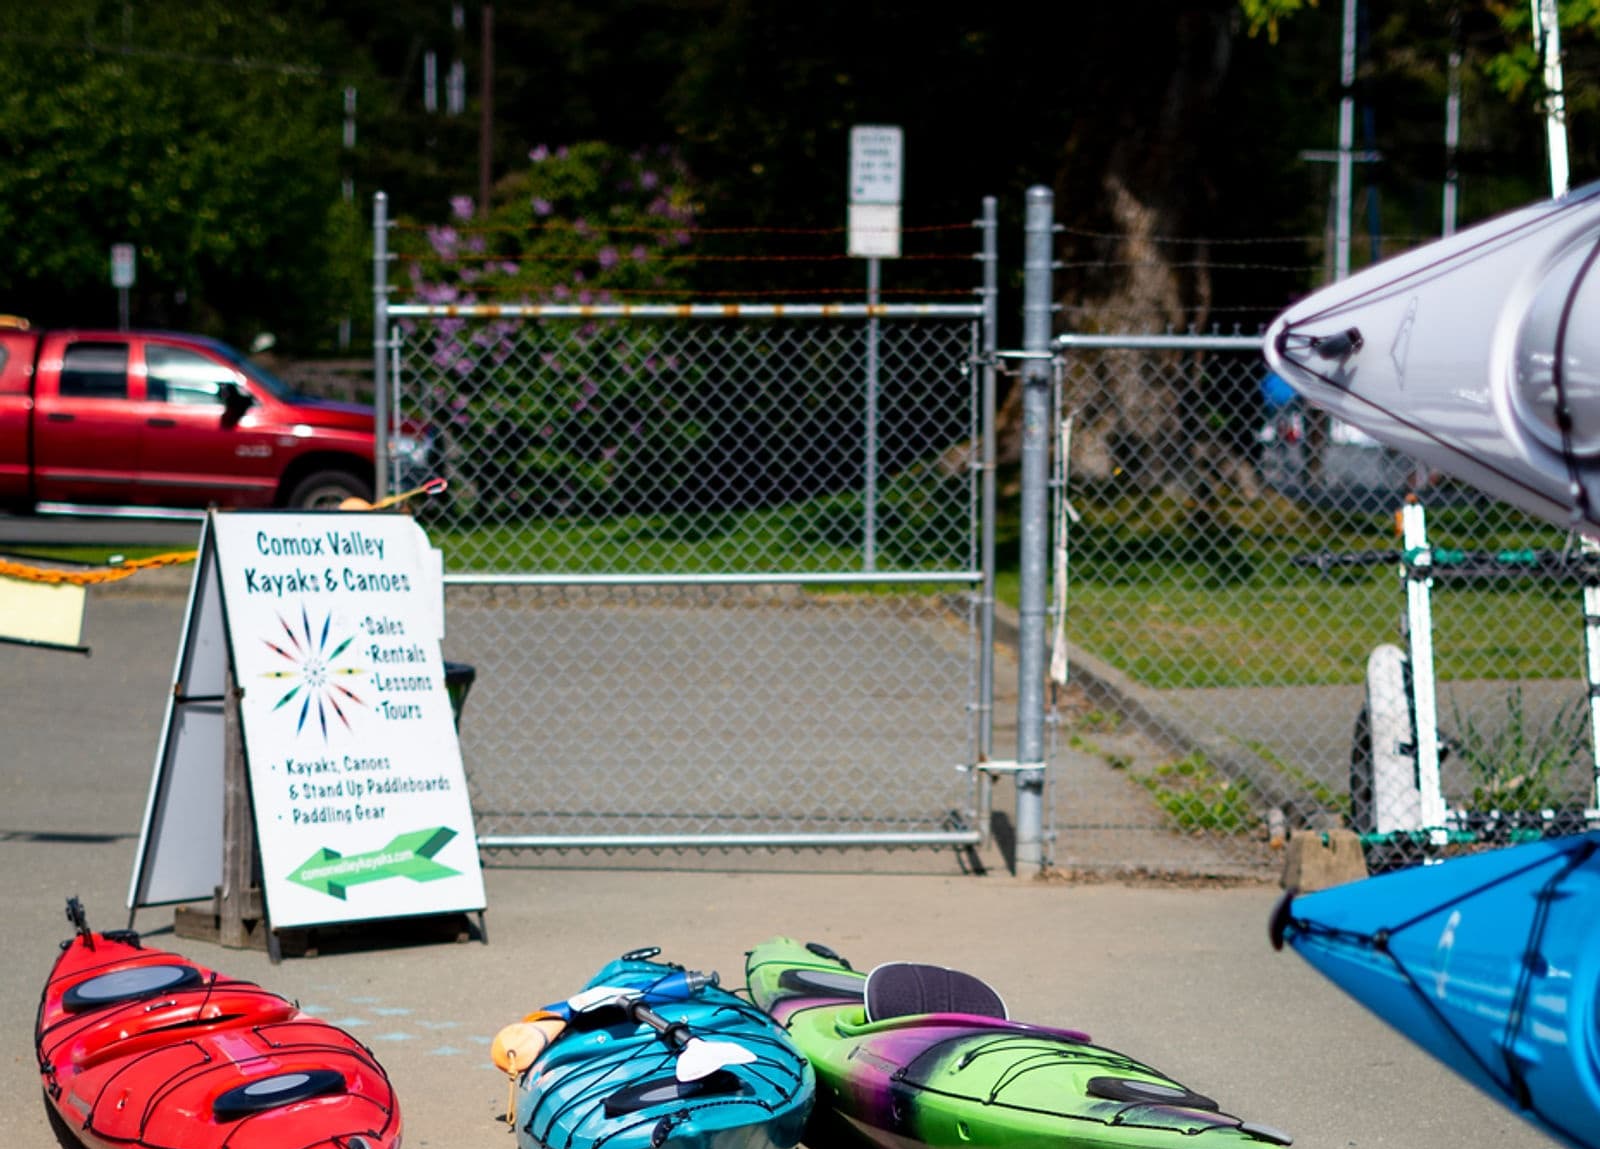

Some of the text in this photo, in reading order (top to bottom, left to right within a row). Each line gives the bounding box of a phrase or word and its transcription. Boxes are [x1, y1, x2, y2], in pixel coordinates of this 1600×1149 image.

[257, 531, 384, 560] Comox Valley
[245, 567, 411, 597] Kayaks & Canoes
[365, 616, 404, 635] Sales
[371, 643, 426, 664] Rentals
[375, 672, 433, 691] Lessons
[382, 700, 422, 720] Tours
[286, 756, 391, 777] Kayaks, Canoes
[289, 775, 451, 800] & Stand Up Paddleboards
[293, 804, 386, 824] Paddling Gear
